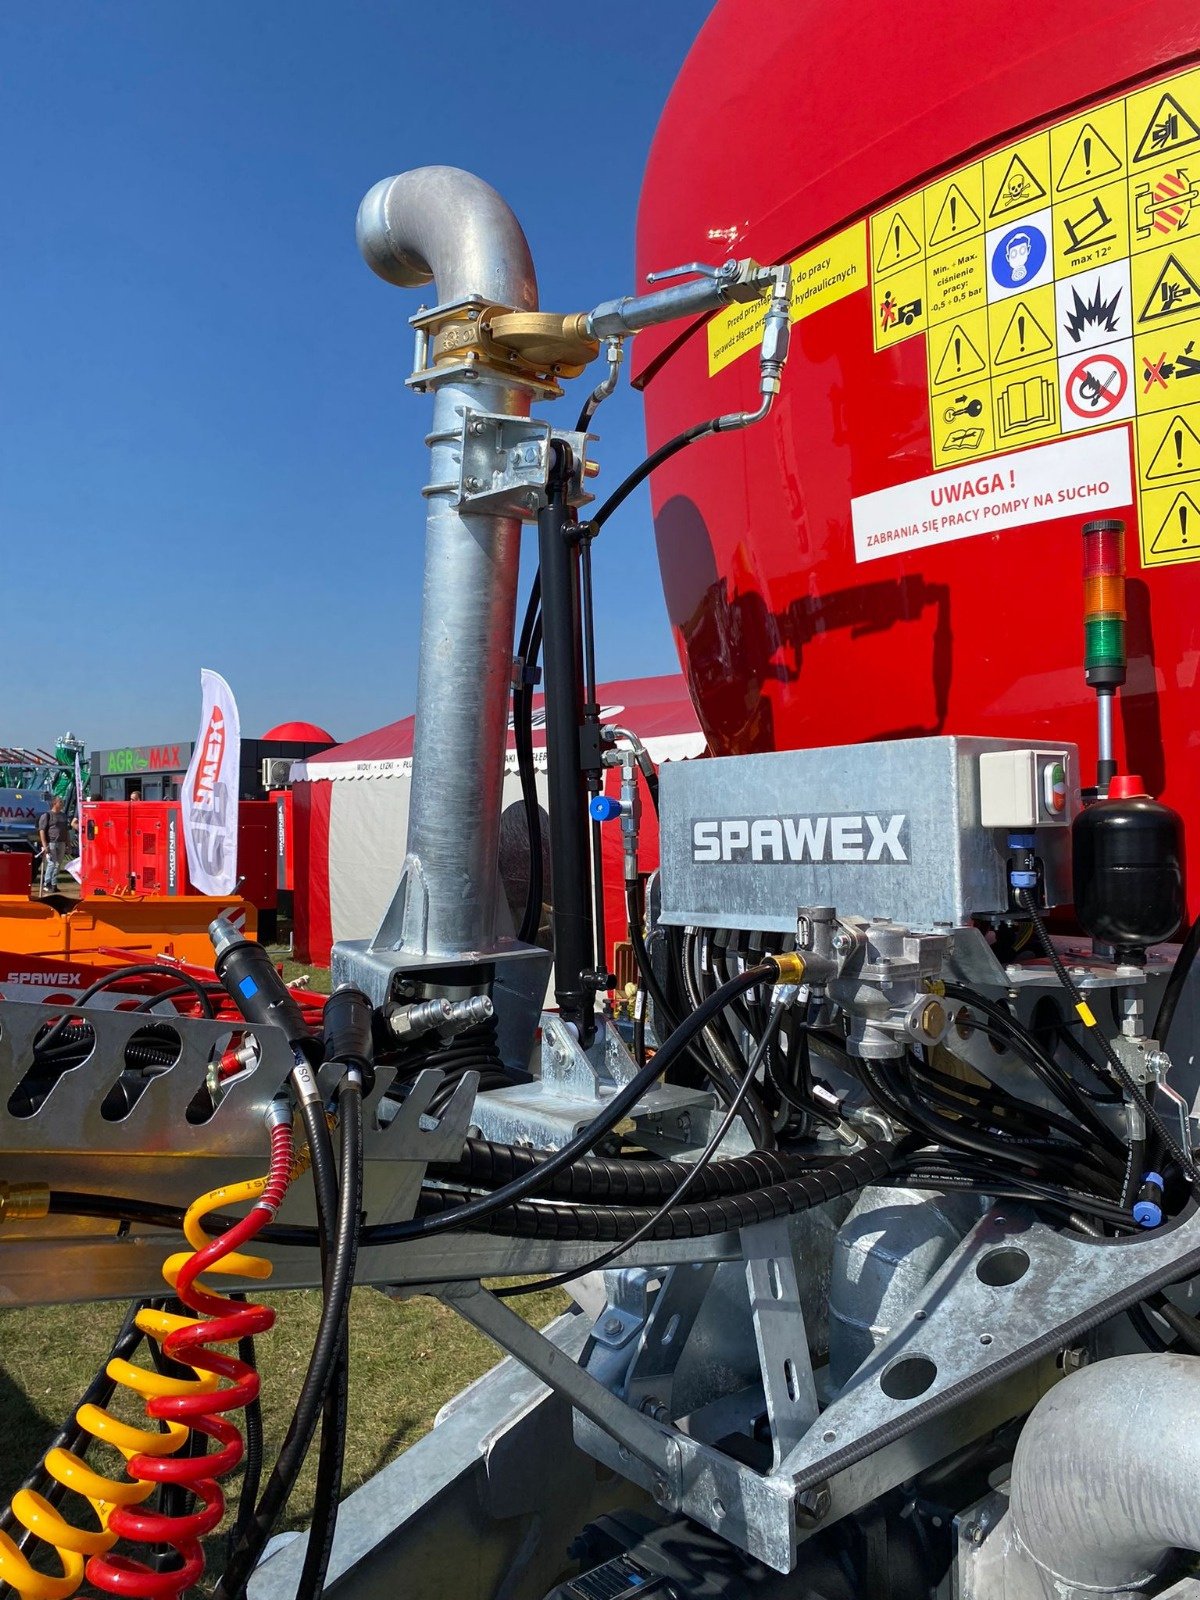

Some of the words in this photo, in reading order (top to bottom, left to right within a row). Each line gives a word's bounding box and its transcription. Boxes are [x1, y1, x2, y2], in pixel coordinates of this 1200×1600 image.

[933, 266, 950, 276] Min.
[957, 254, 978, 266] Max.
[1071, 254, 1093, 267] max
[795, 264, 857, 304] hydraulicznych
[937, 267, 974, 287] ciśnienie
[727, 311, 743, 329] Przed
[796, 272, 807, 283] do
[808, 258, 831, 279] pracy
[943, 280, 968, 297] pracy:
[968, 287, 983, 298] bar
[930, 473, 1005, 507] UWAGA
[867, 524, 919, 547] ZABRANIA
[922, 519, 939, 532] SIĘ
[941, 509, 980, 528] PRACY
[983, 497, 1030, 518] POMPY
[1033, 493, 1054, 507] NA
[1057, 481, 1110, 503] SUCHO
[693, 814, 908, 861] SPAWEX
[7, 972, 82, 985] SPAWEX
